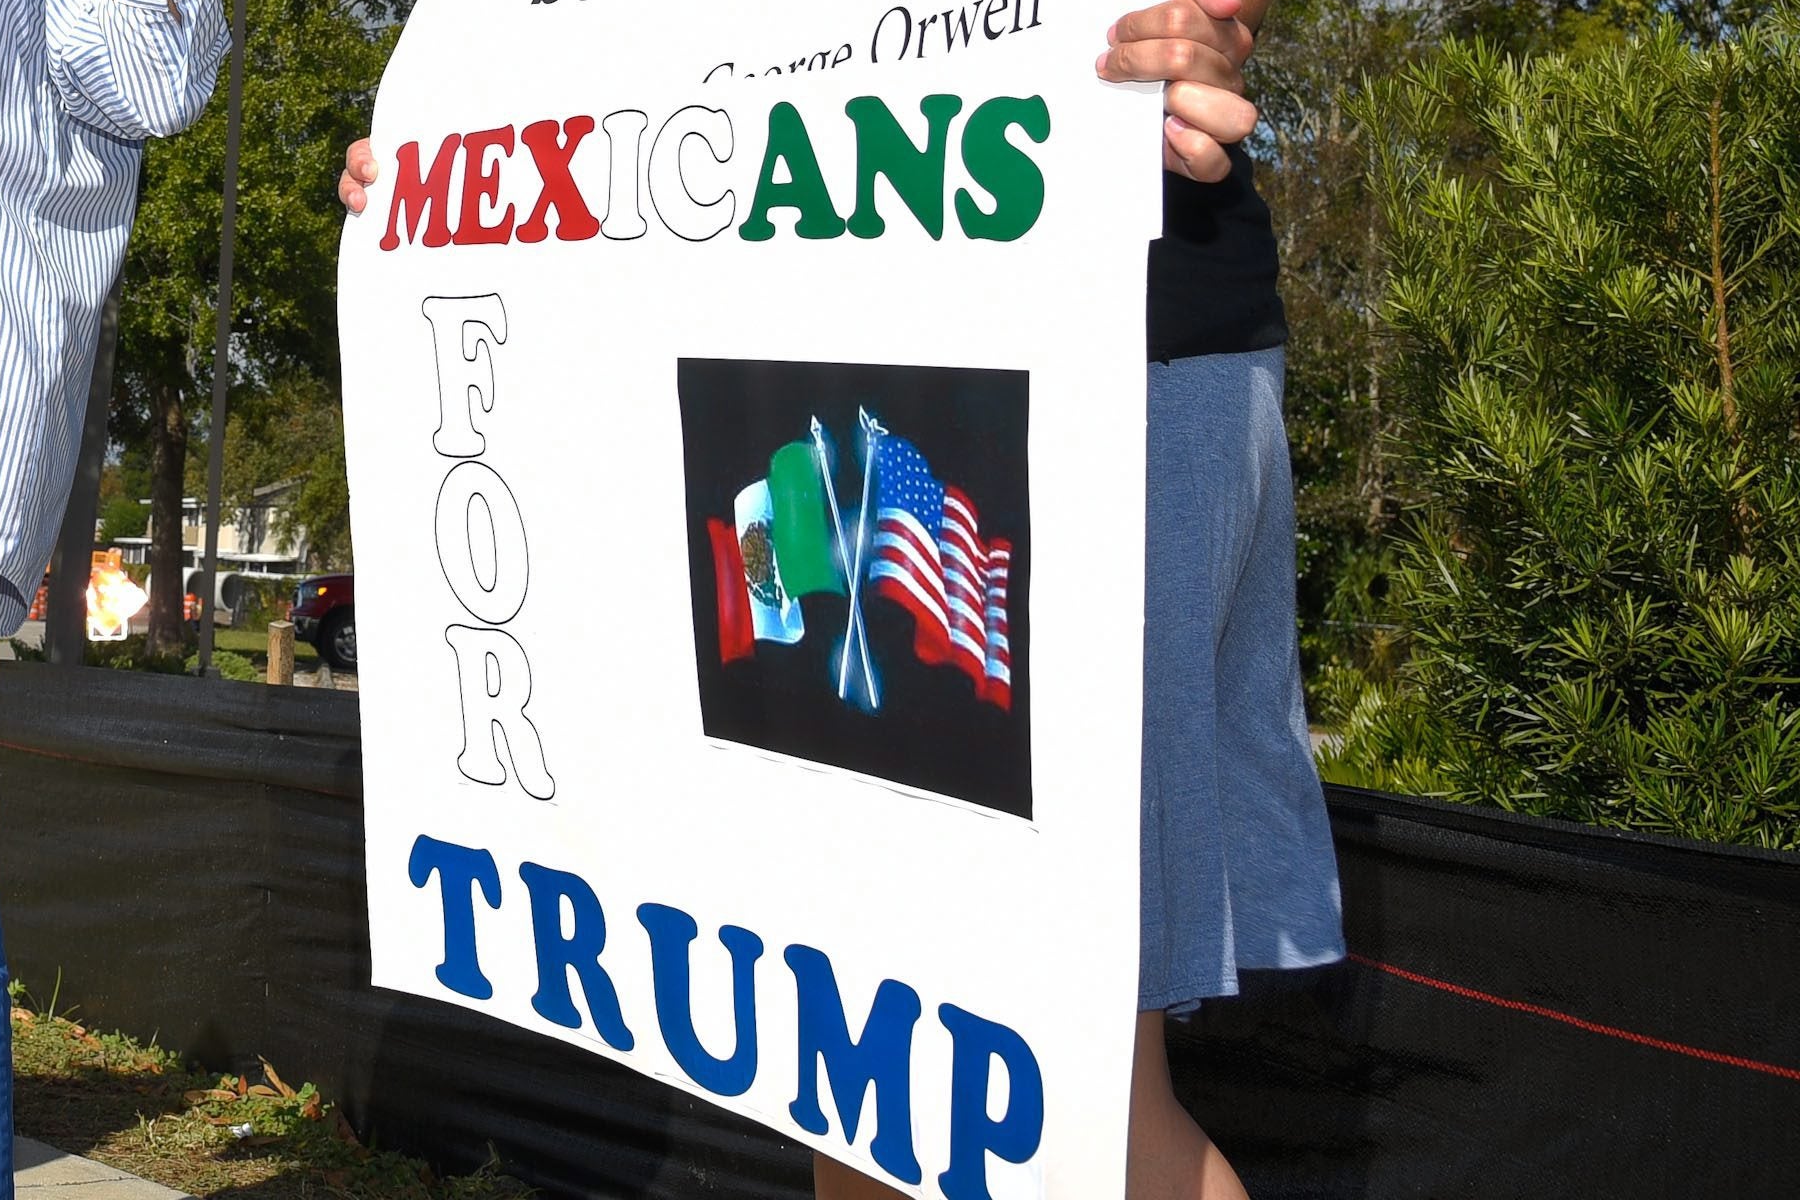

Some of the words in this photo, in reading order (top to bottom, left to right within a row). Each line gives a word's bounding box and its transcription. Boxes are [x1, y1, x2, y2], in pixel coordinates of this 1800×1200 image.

[380, 94, 1050, 251] MEXICANS
[422, 292, 555, 800] FOR
[408, 834, 1044, 1200] TRUMP
